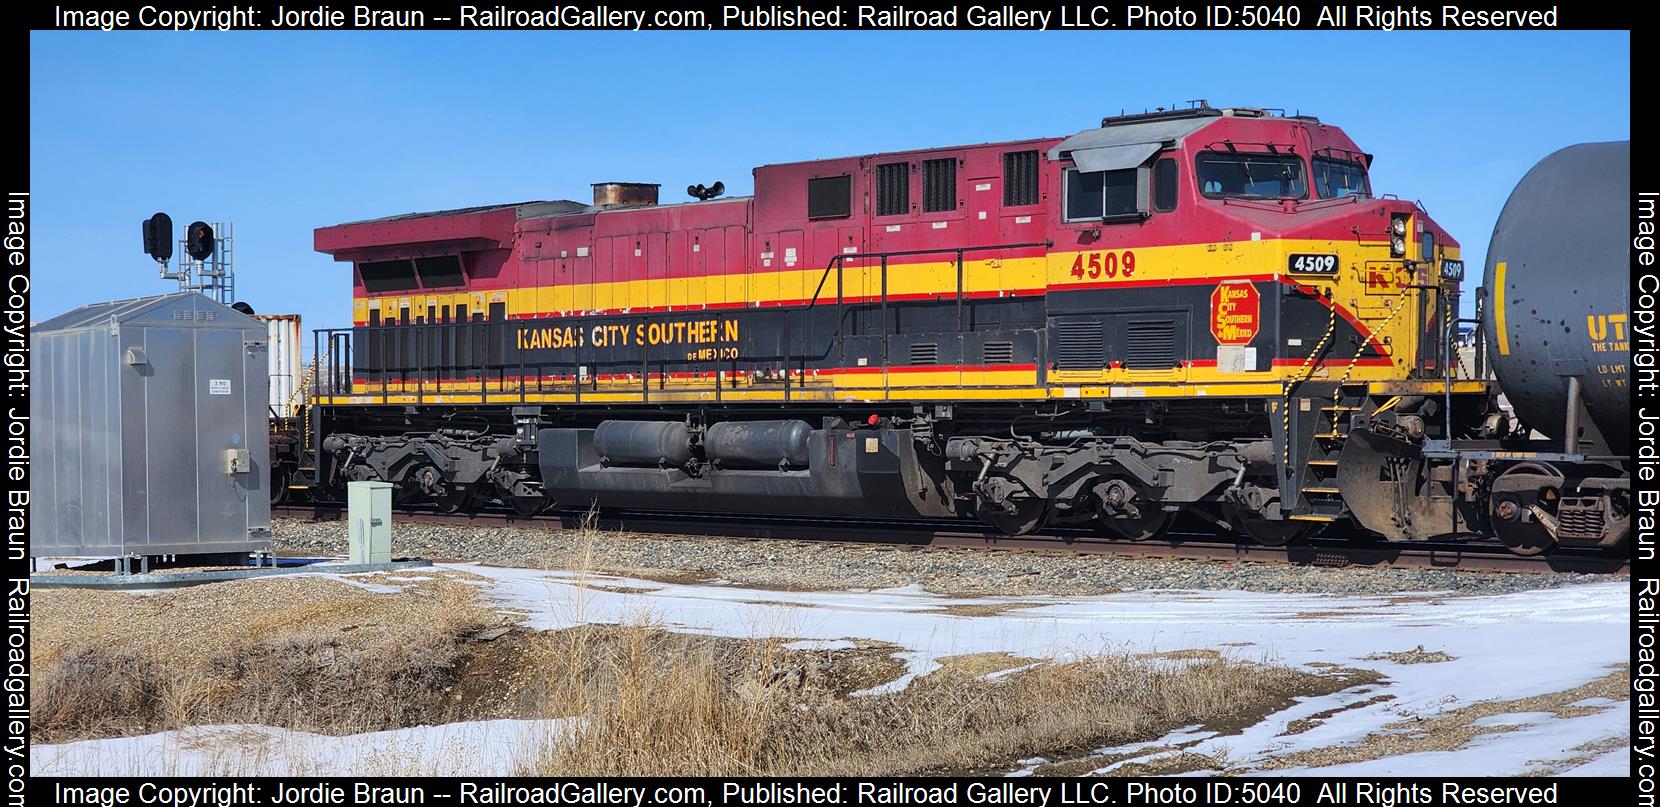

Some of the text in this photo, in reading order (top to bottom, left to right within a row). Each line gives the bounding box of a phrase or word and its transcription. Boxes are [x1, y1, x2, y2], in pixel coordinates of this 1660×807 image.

[1071, 251, 1136, 280] 4509
[1295, 256, 1335, 272] 4509
[1443, 262, 1462, 277] 4509
[1220, 286, 1248, 303] KANSAS
[517, 319, 739, 350] KANSAS CITY SOUTHERN
[687, 347, 739, 361] DE MEXICO
[1592, 342, 1607, 352] THE
[1271, 401, 1279, 414] F
